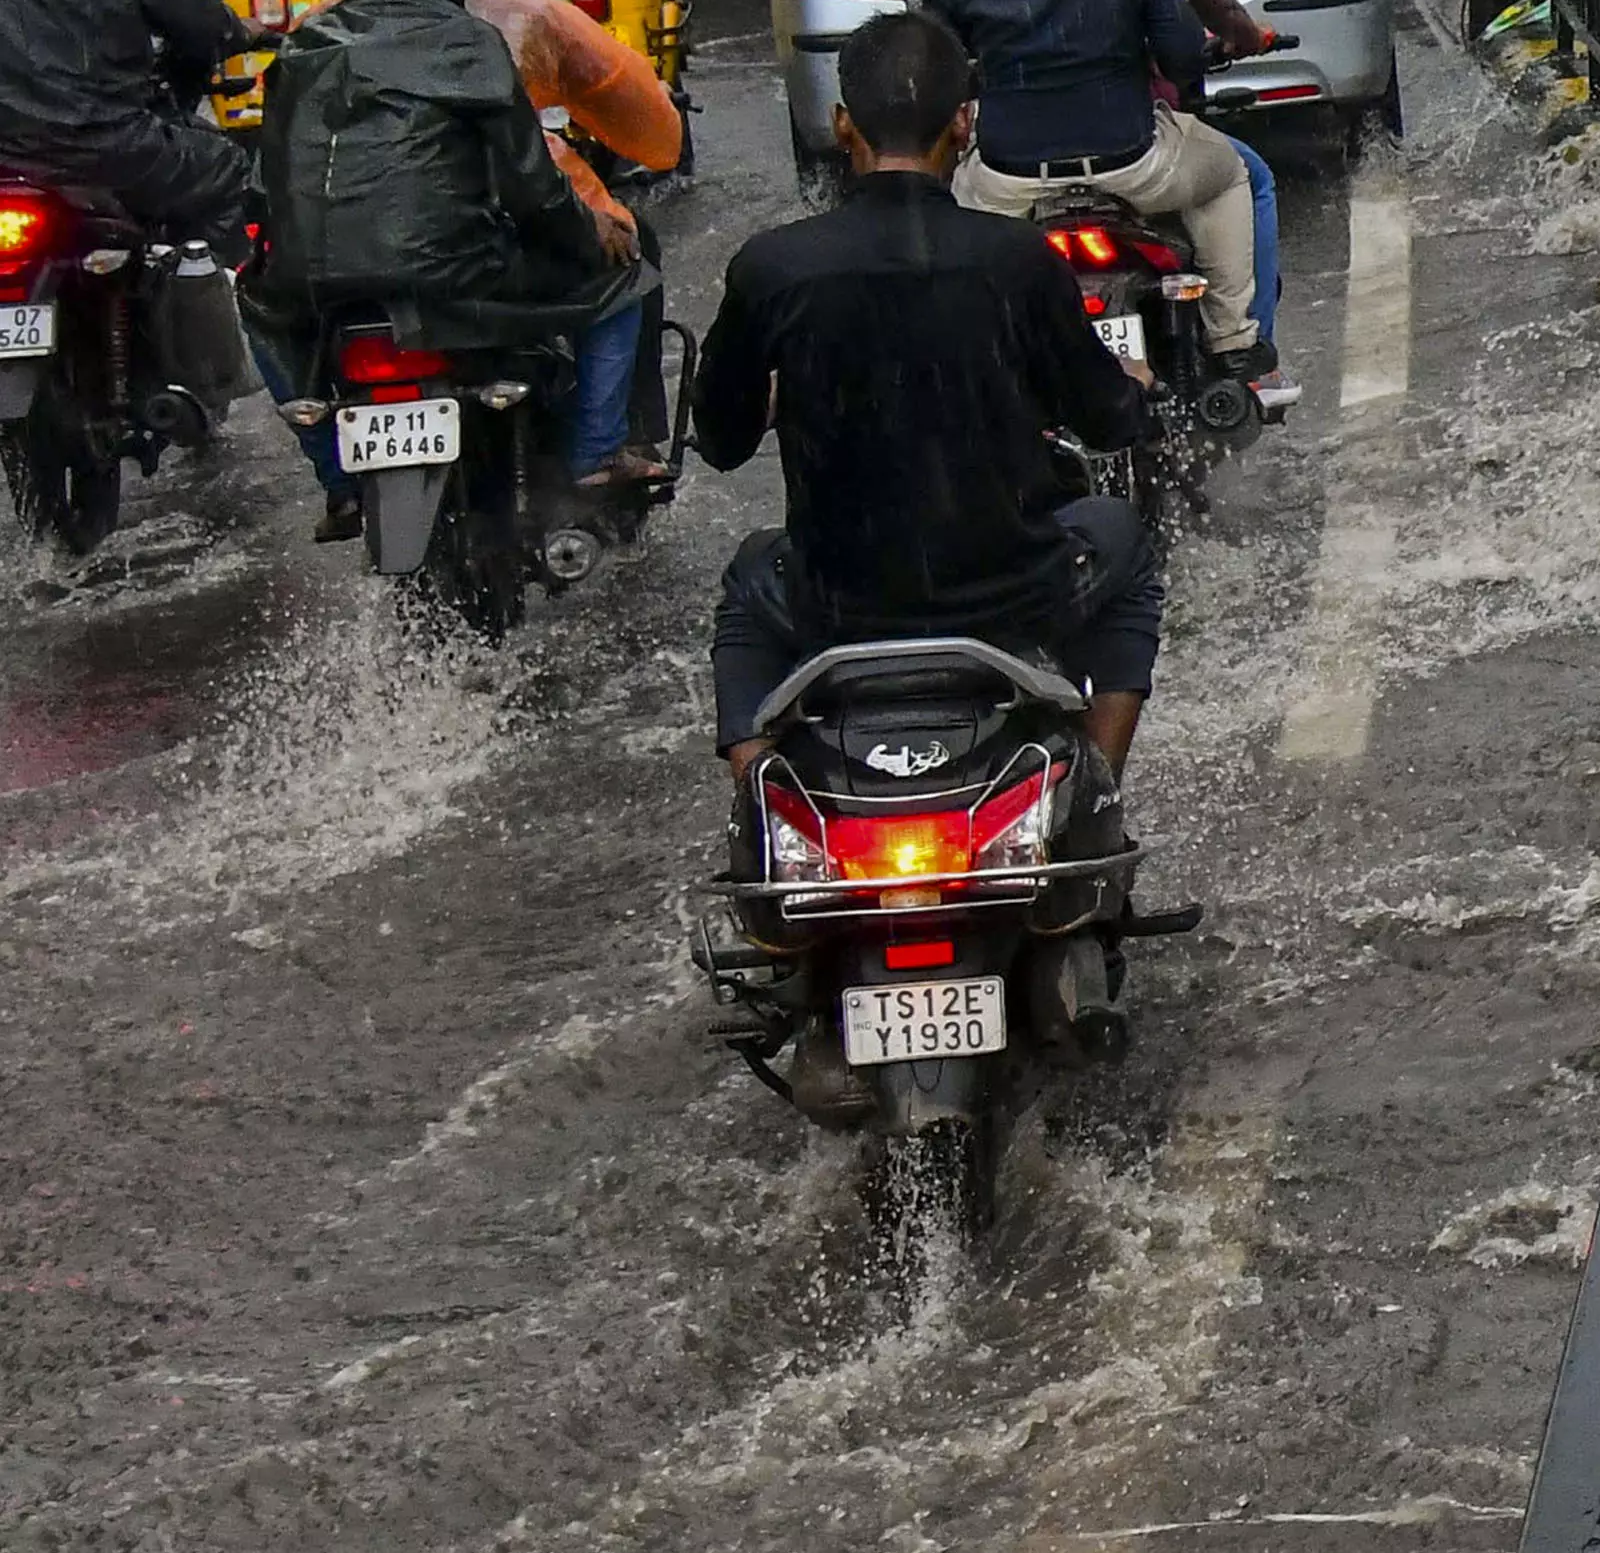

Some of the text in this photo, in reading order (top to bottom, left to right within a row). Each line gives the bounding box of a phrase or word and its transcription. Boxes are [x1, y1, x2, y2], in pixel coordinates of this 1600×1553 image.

[14, 308, 41, 327] 07
[368, 411, 425, 435] AP 11
[352, 434, 446, 463] AP 6446
[873, 984, 984, 1023] TS12E
[875, 1019, 984, 1057] Y1930
